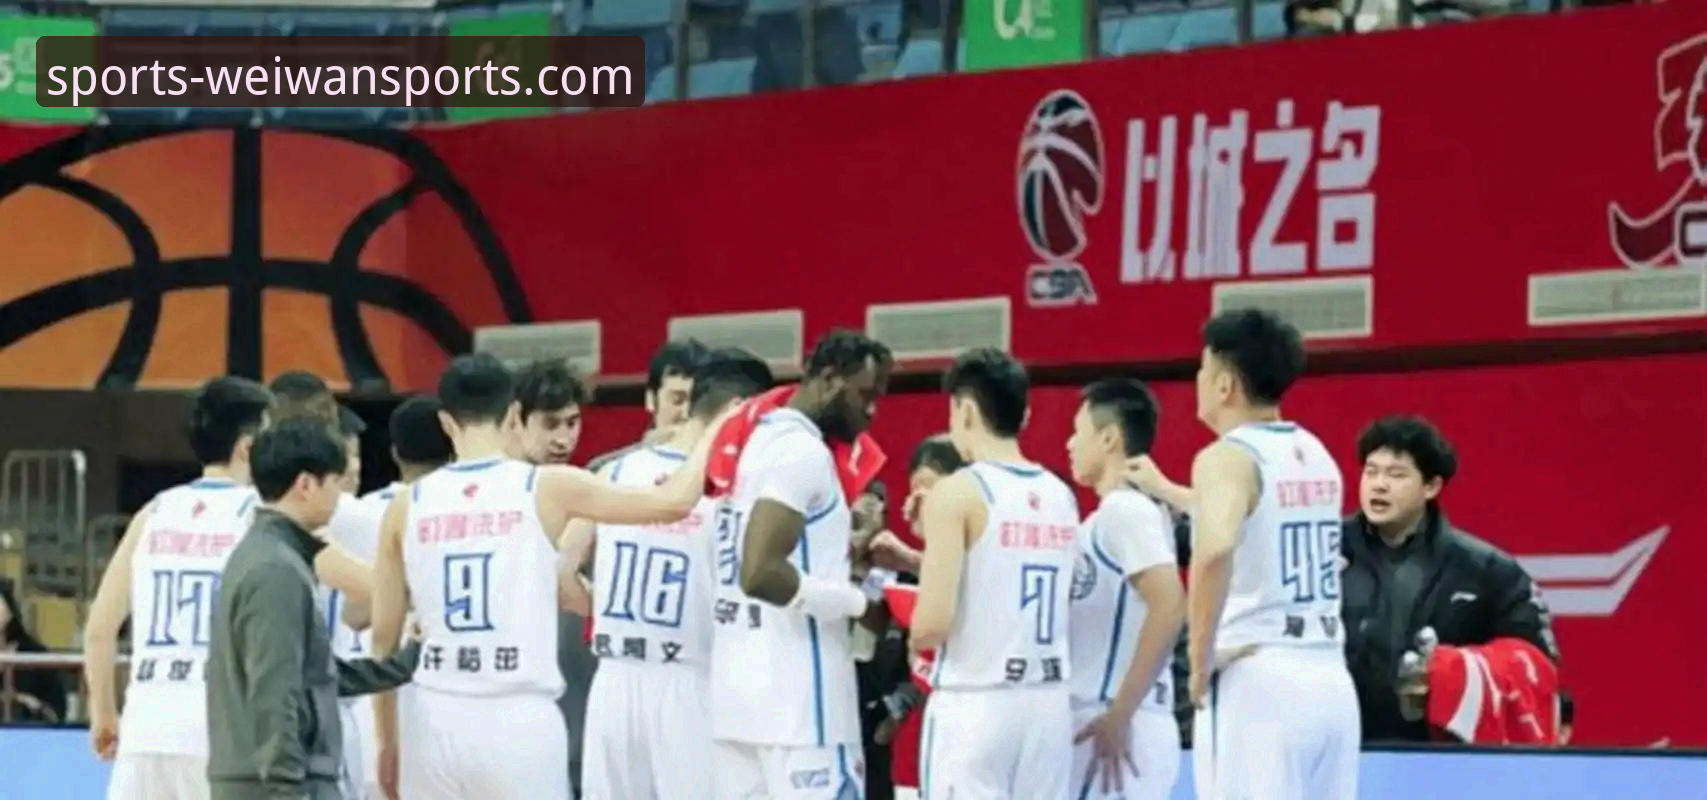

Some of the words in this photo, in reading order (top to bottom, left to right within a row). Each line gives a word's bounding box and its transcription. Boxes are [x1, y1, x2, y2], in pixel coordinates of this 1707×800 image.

[1120, 99, 1381, 283] 以城之名
[443, 551, 494, 633] 9
[602, 541, 690, 628] 16
[1019, 563, 1059, 646] 7
